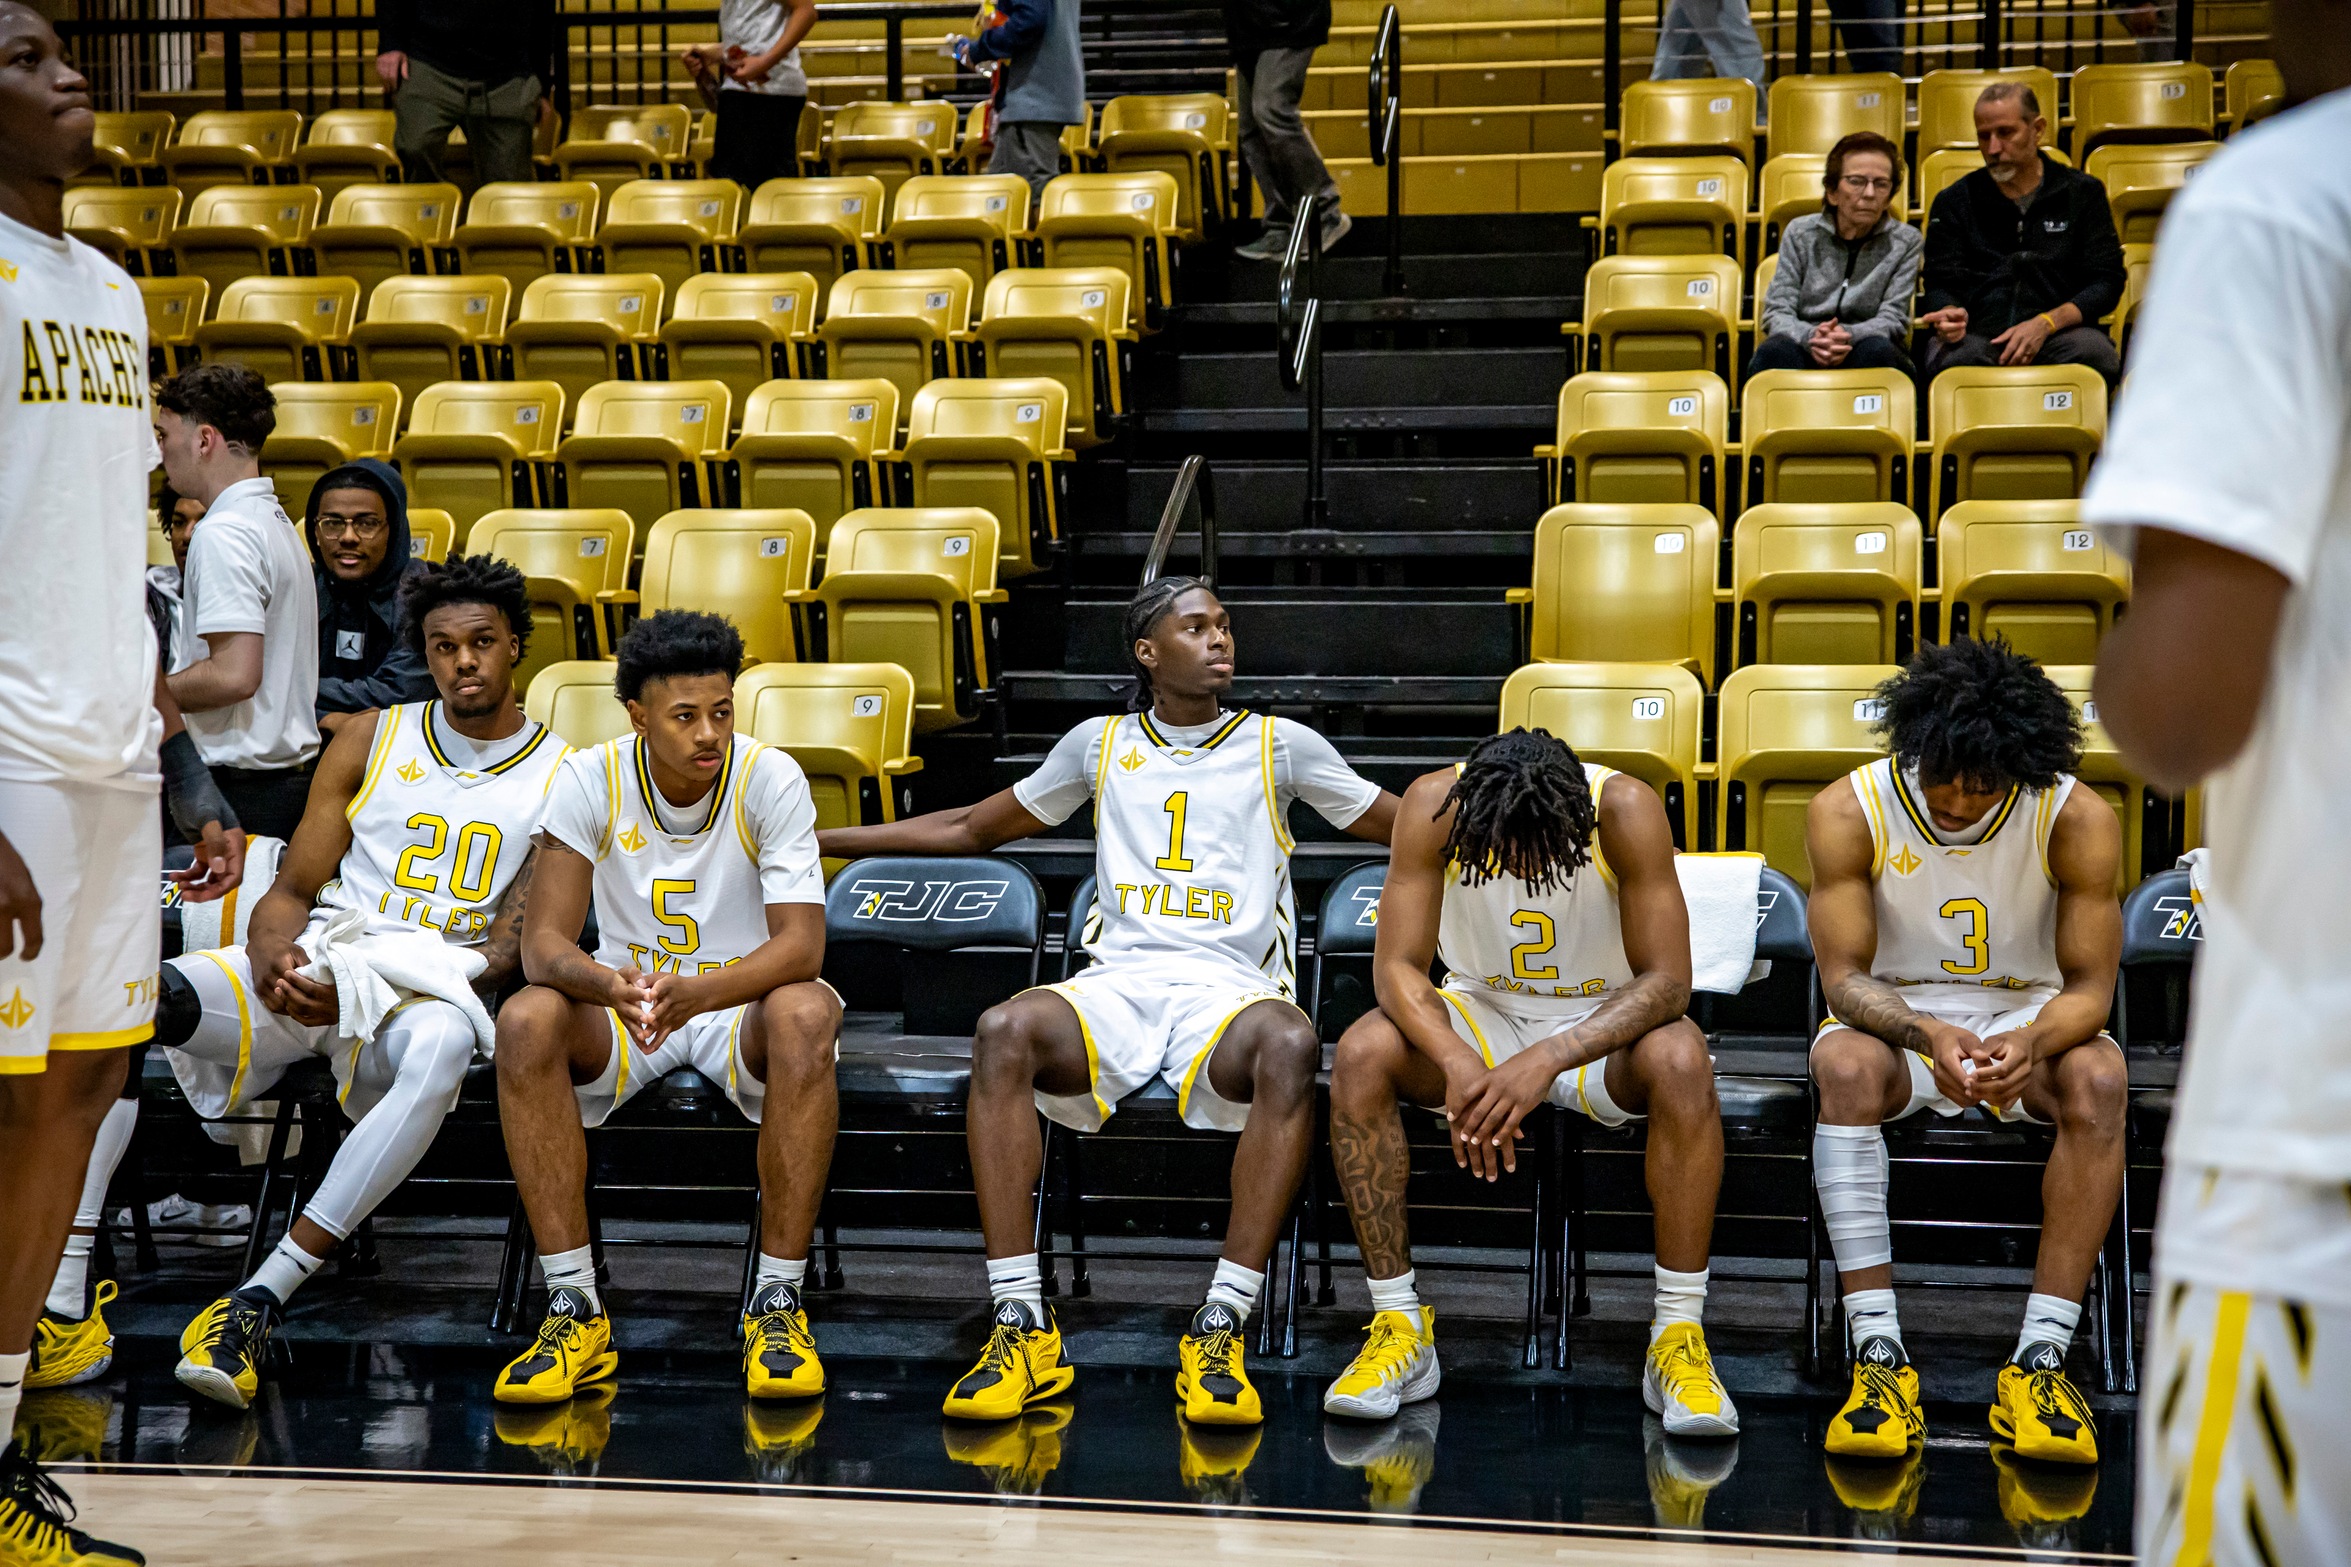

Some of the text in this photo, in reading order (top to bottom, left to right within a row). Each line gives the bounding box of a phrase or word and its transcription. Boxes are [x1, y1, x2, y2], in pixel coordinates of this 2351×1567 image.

[1715, 99, 1728, 110] 10
[1702, 181, 1717, 192] 10
[1693, 282, 1708, 293] 10
[779, 298, 786, 309] 7
[933, 296, 941, 307] 8
[1089, 294, 1097, 304] 9
[1675, 400, 1691, 412] 10
[1861, 398, 1875, 410] 11
[2049, 395, 2067, 407] 12
[361, 410, 369, 423] 5
[523, 410, 531, 421] 6
[689, 409, 697, 420] 7
[856, 408, 865, 420] 8
[1025, 407, 1033, 419] 9
[410, 540, 418, 553] 6
[589, 540, 598, 553] 7
[769, 541, 778, 554] 8
[952, 540, 961, 552] 9
[1662, 537, 1680, 550] 10
[1863, 537, 1878, 550] 11
[2070, 534, 2089, 548] 12
[863, 699, 873, 713] 9
[1639, 701, 1659, 716] 10
[1155, 791, 1193, 872] 1
[395, 812, 503, 903] 20
[849, 879, 1010, 921] TJC
[1115, 883, 1233, 925] TYLER
[651, 878, 701, 955] 5
[1939, 897, 1989, 975] 3
[1510, 909, 1559, 979] 2
[123, 971, 160, 1007] TYL
